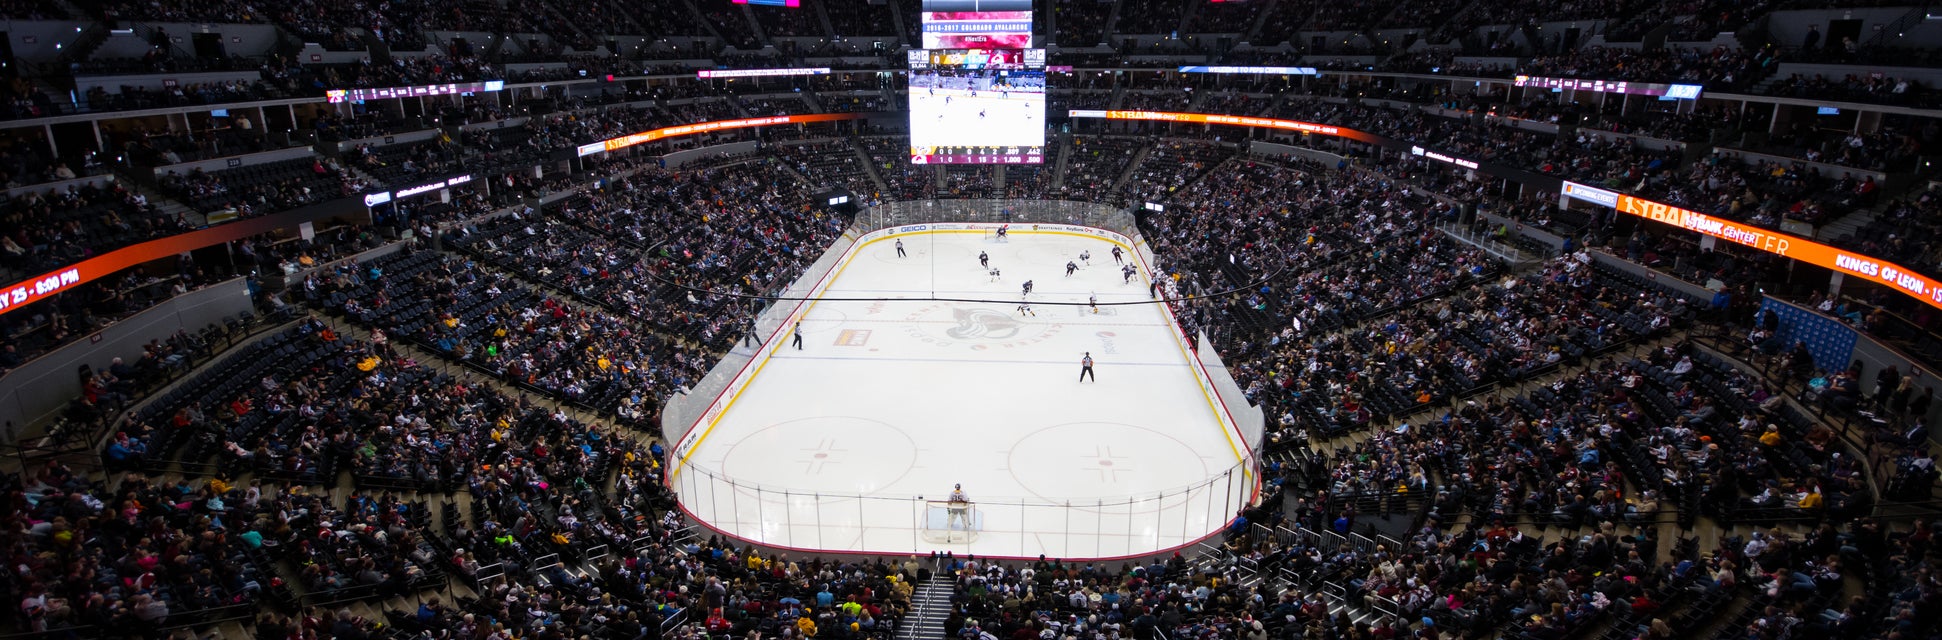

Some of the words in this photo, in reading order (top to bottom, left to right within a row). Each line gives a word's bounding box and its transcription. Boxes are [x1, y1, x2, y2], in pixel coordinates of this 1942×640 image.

[961, 23, 992, 31] COLORADO
[994, 23, 1028, 31] AVALANCHE
[1574, 187, 1597, 199] UPCOMING
[1597, 192, 1614, 204] EVENTS
[900, 225, 927, 233] GEICO
[1835, 254, 1879, 277] KINGS
[1881, 266, 1898, 282] OF
[1896, 272, 1925, 295] LEON
[11, 286, 28, 304] 25
[35, 275, 60, 295] 8:00
[60, 268, 80, 286] PM
[683, 432, 697, 450] RAM
